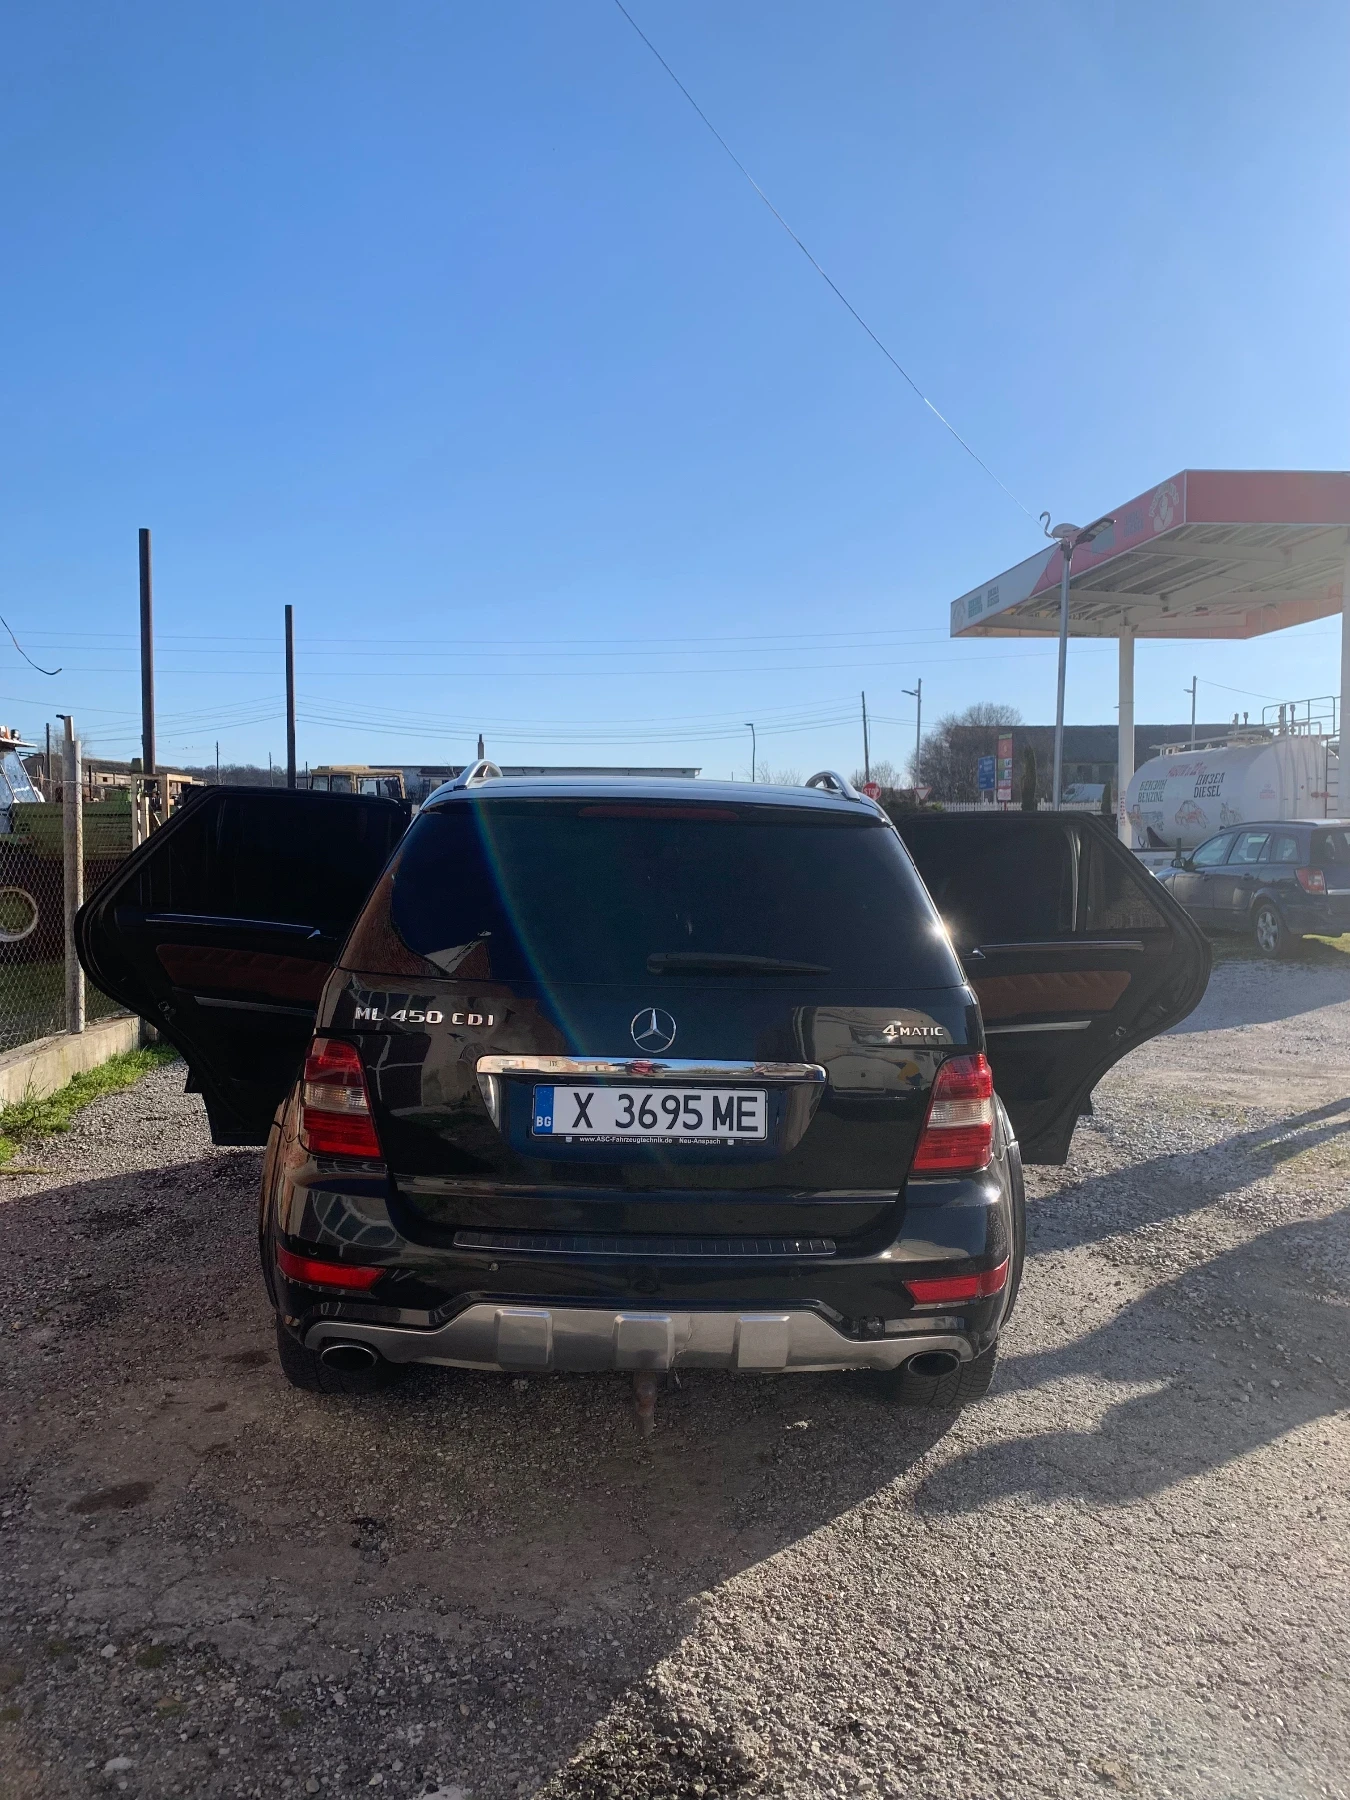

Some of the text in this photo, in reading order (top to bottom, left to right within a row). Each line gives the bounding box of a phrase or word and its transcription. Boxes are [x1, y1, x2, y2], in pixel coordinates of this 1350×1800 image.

[1196, 772, 1225, 785] ДИЗЕЛ
[1137, 791, 1164, 803] BENZINE
[1193, 785, 1221, 798] DIESEL
[354, 1006, 494, 1026] ML 450 CDI
[571, 1092, 595, 1129] X
[536, 1115, 552, 1127] BG
[579, 1136, 721, 1145] www.ASC-Fahrzeugtechnik.de Neu-Anspach
